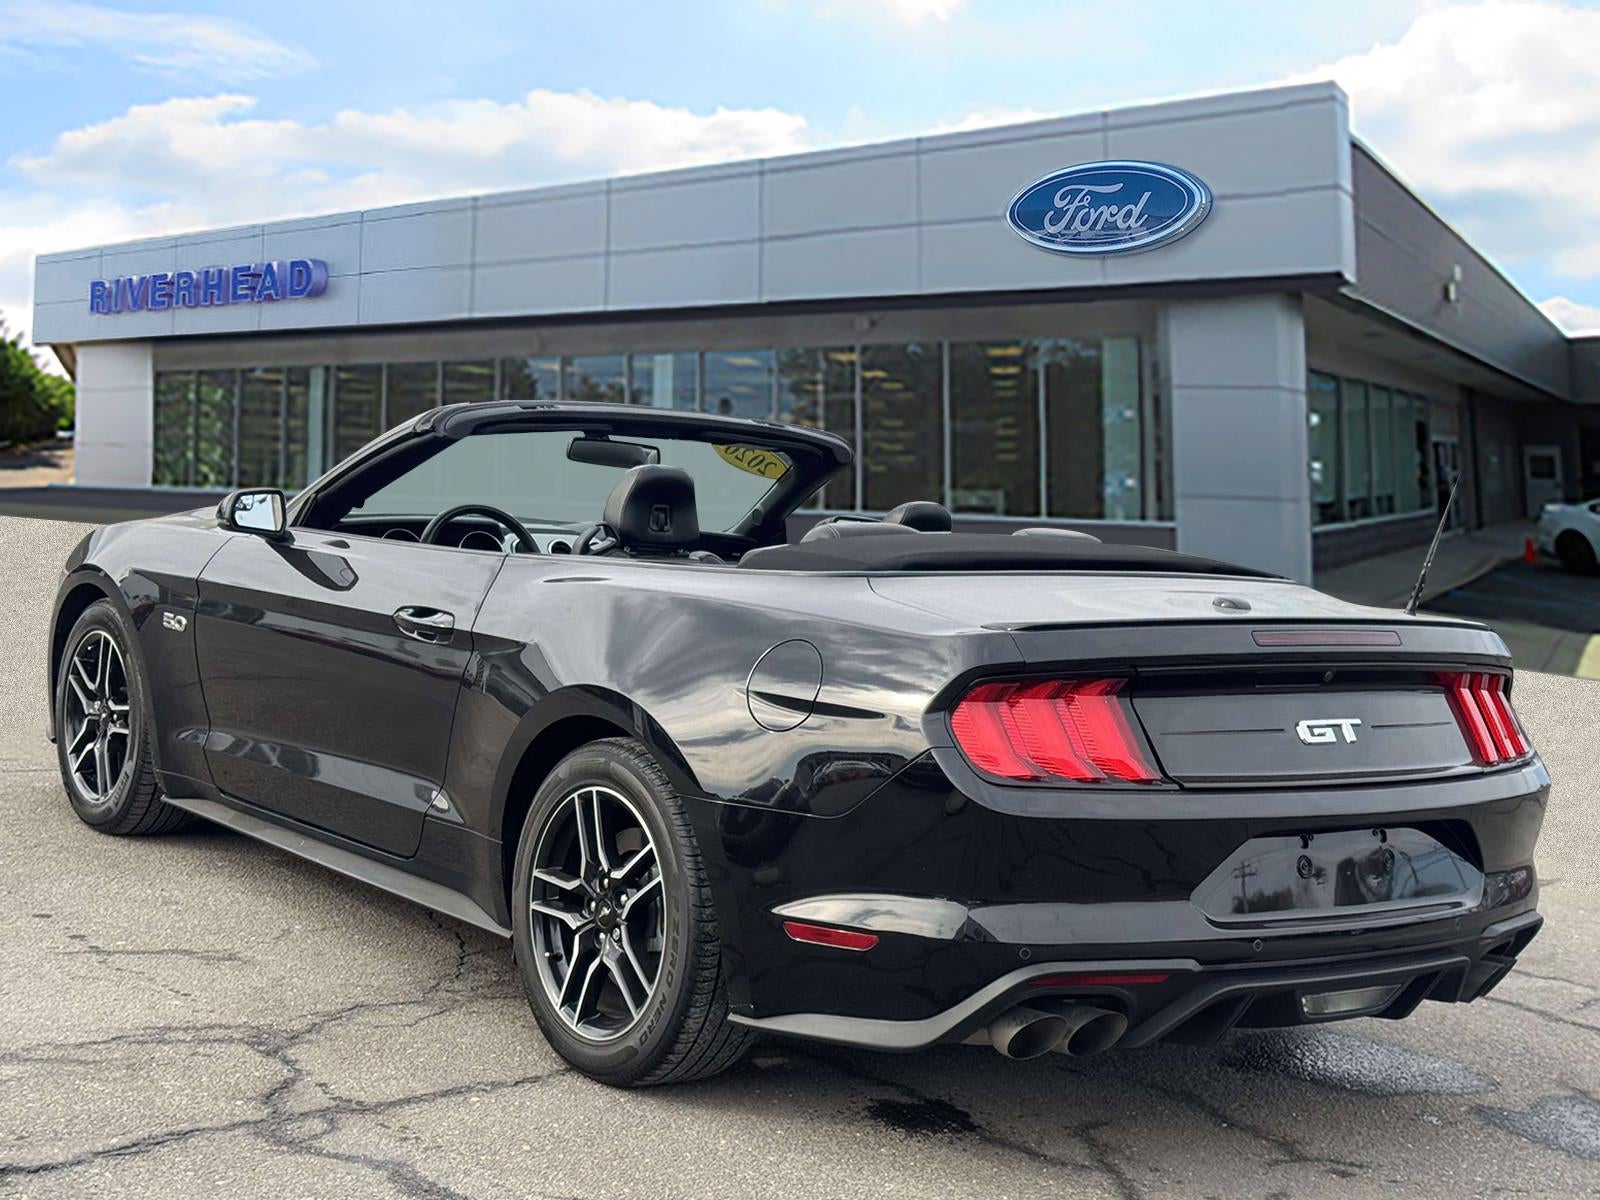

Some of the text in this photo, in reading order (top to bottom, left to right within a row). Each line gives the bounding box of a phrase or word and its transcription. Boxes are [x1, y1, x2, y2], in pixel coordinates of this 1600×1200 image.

[1043, 182, 1152, 234] Ford
[88, 258, 328, 315] RIVERHEAD
[1295, 718, 1362, 745] GT
[638, 993, 668, 1047] NERO
